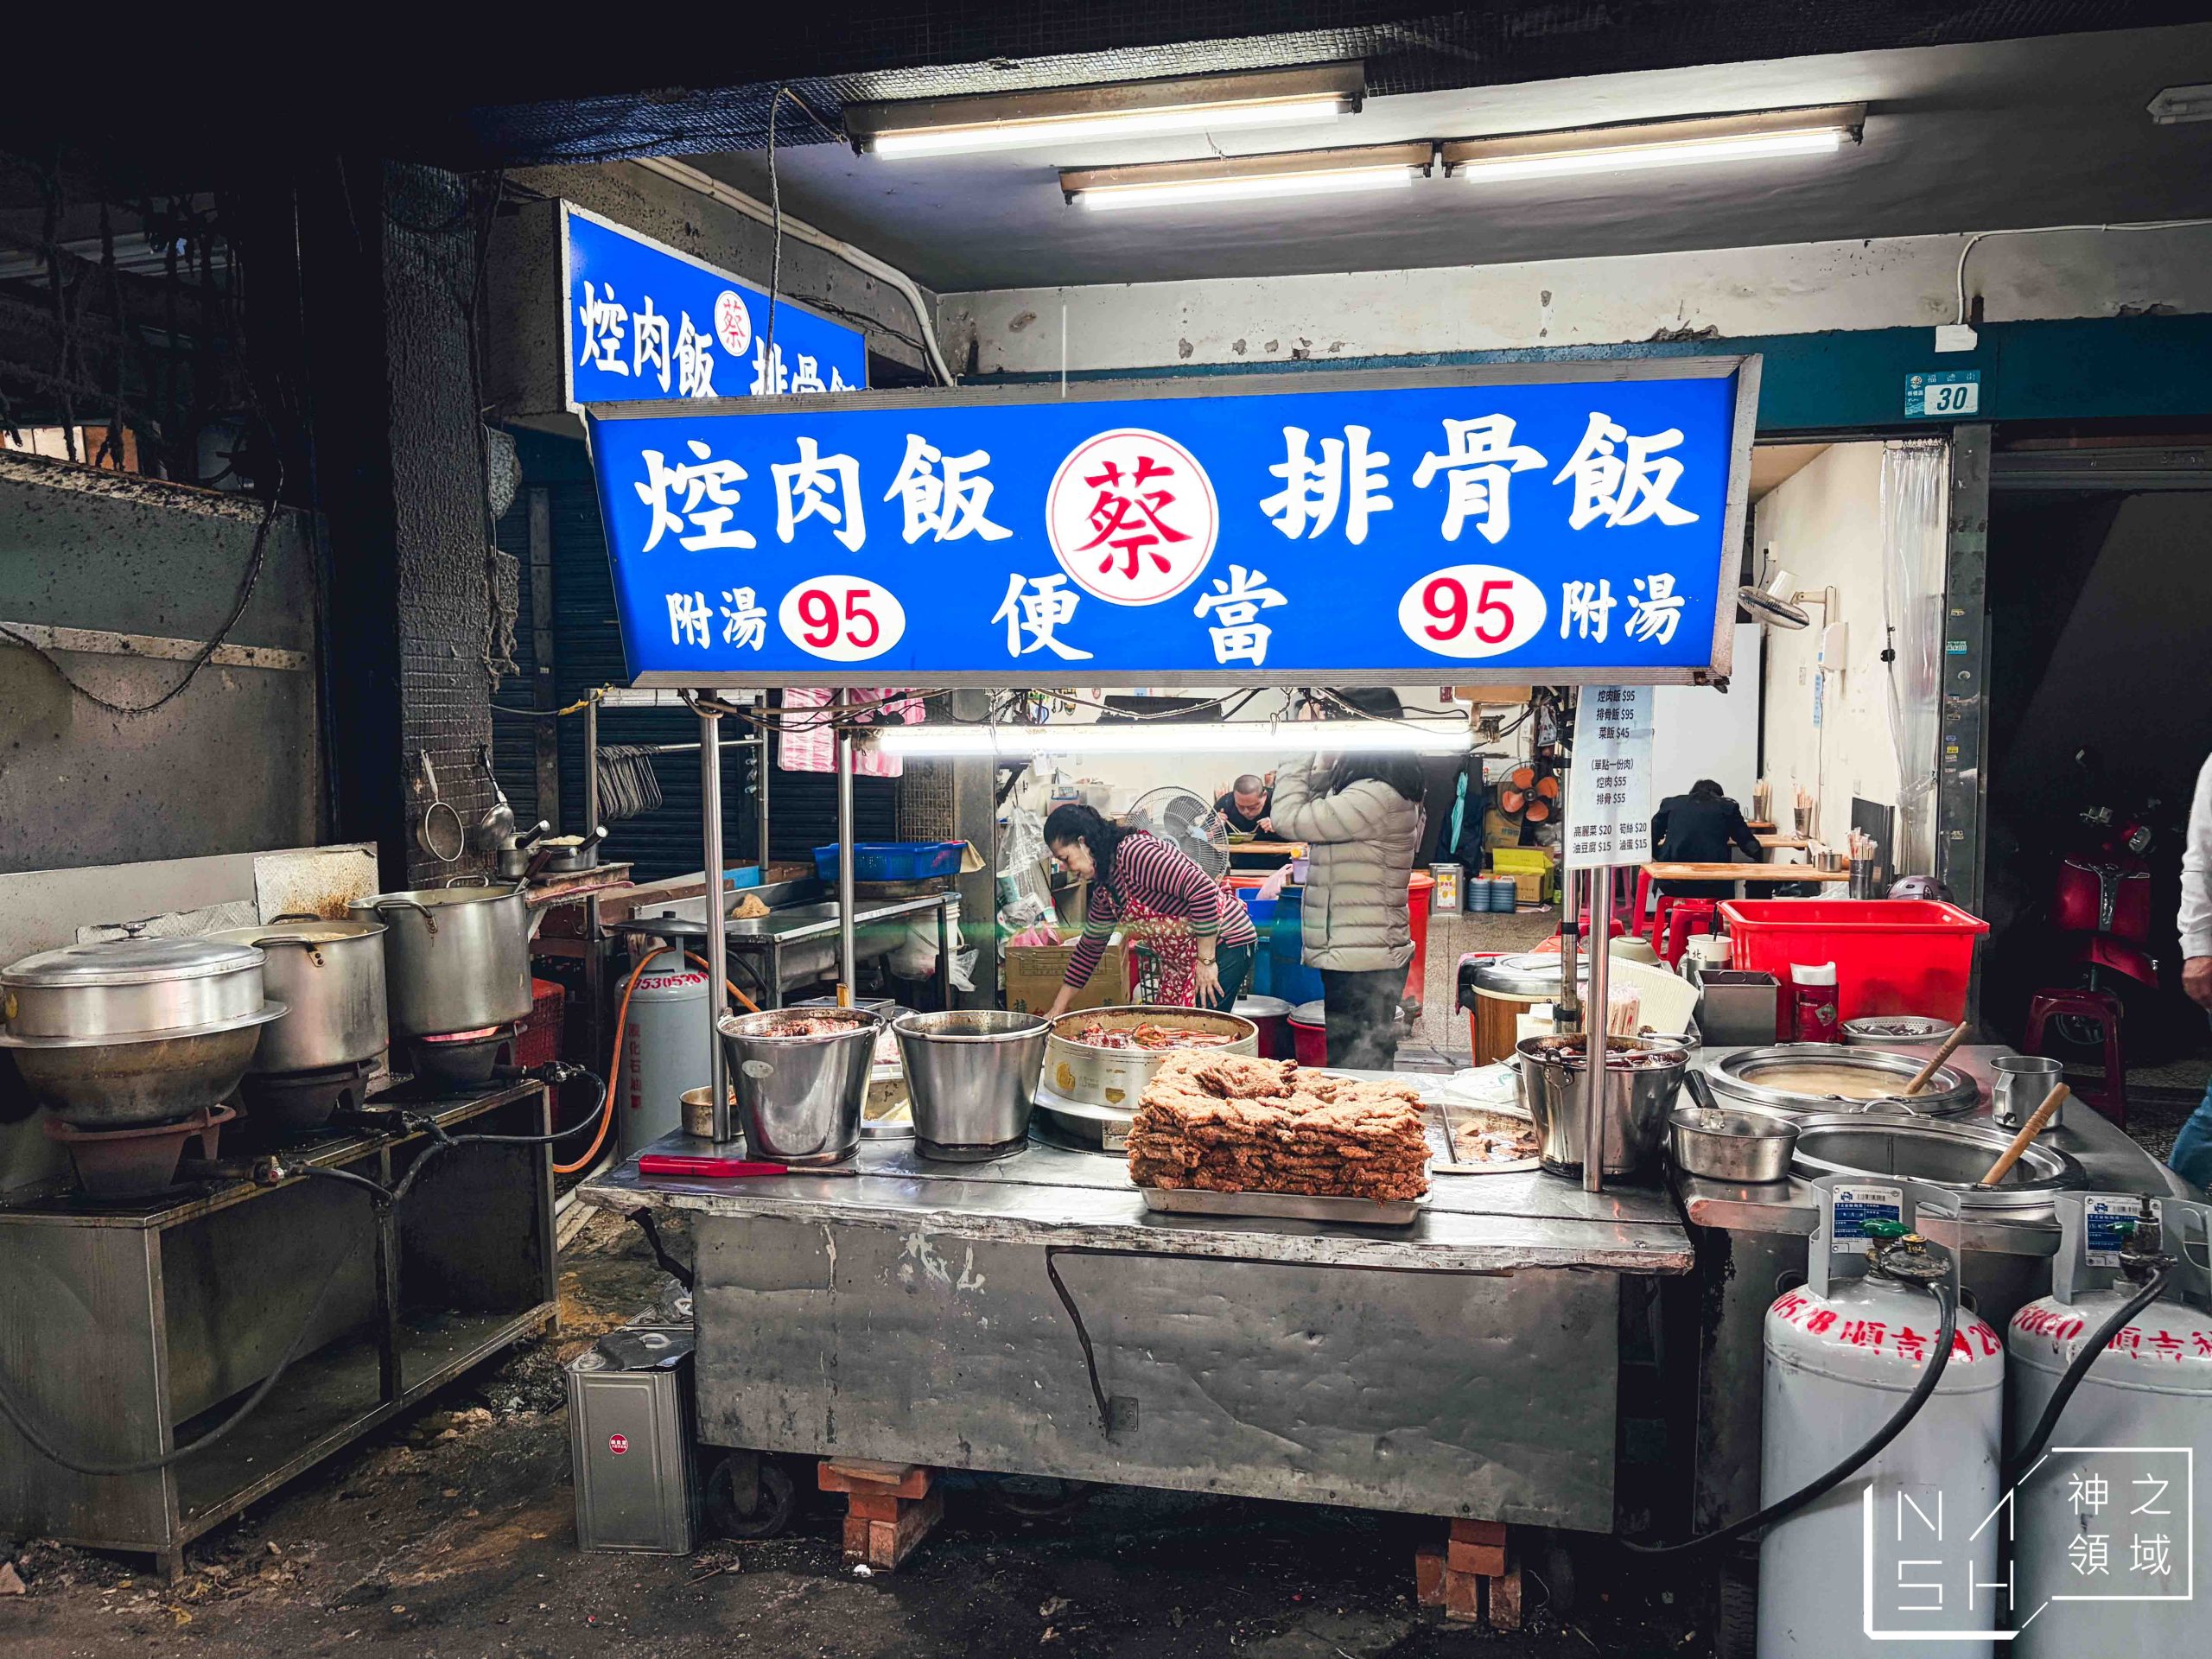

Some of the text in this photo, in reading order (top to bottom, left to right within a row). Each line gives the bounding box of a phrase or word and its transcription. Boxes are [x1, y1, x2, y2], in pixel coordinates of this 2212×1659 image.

[721, 299, 747, 349] 蔡
[580, 281, 718, 398] 焢肉飯
[1937, 386, 1967, 411] 30
[1259, 411, 1700, 544] 排骨飯
[634, 434, 1013, 553] 焢肉飯
[1073, 456, 1193, 580] 蔡
[666, 587, 766, 652] 附湯
[798, 589, 879, 648] 95
[1422, 577, 1514, 644] 95
[1560, 572, 1685, 645] 附湯
[1597, 689, 1635, 702] 焢肉飯 $95
[1596, 708, 1634, 721] 排骨飯 $95
[1599, 727, 1630, 740] 菜飯 $45
[1596, 776, 1627, 788] 焢肉 $55
[1596, 792, 1626, 804] 排骨 $55
[1573, 824, 1612, 837] 高麗菜 $20
[1635, 822, 1647, 833] $20
[1573, 842, 1611, 854] 油豆腐 $15
[1635, 838, 1648, 850] $15
